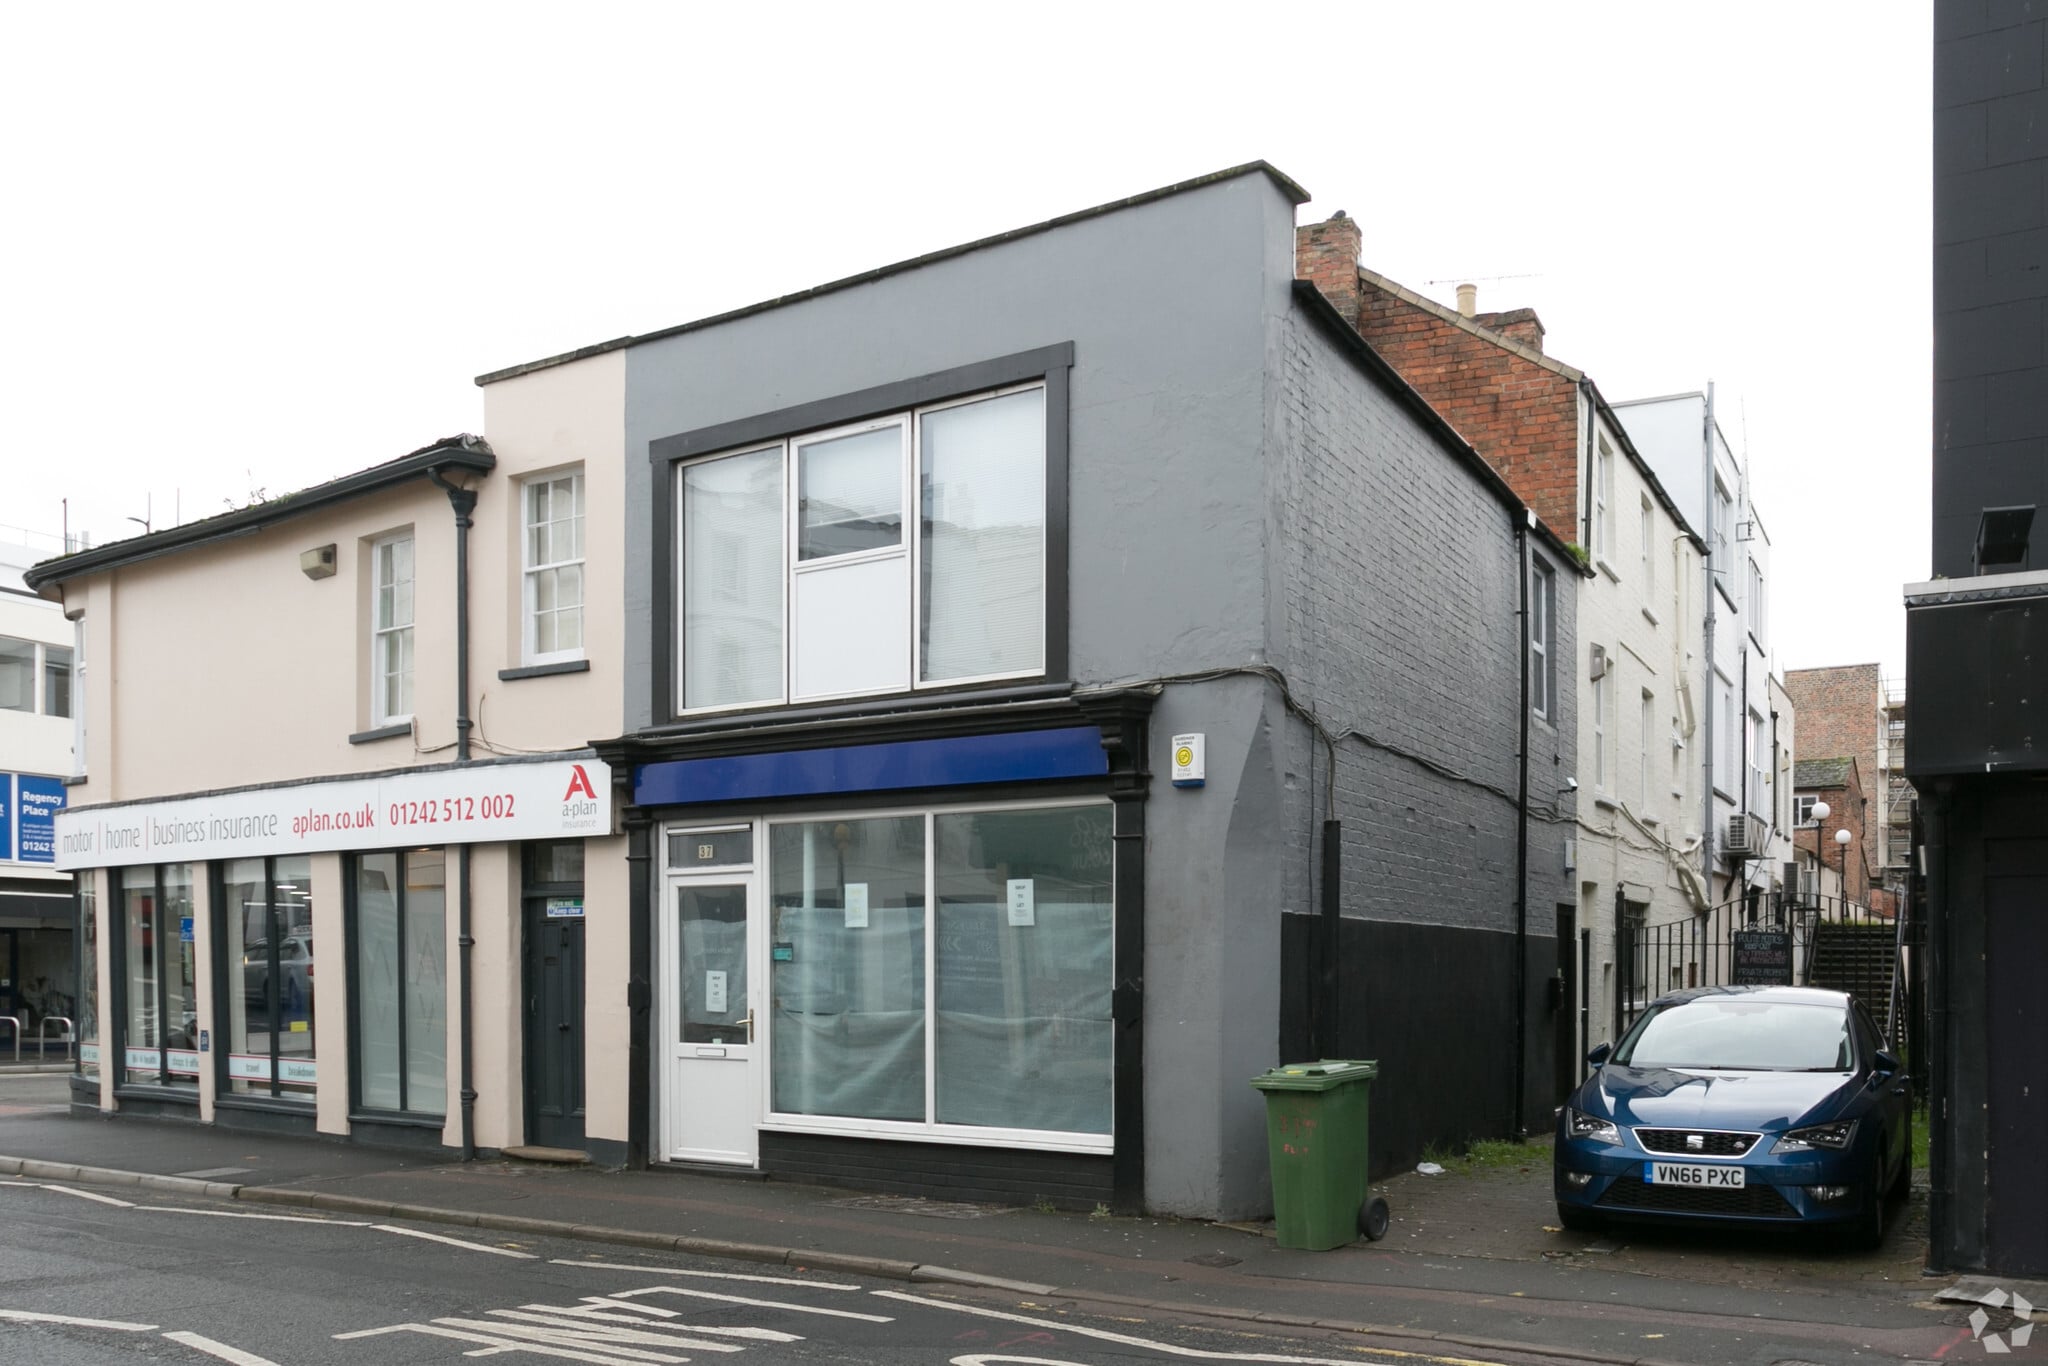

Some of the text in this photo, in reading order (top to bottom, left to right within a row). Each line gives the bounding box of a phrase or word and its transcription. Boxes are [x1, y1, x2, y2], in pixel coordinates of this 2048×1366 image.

[22, 791, 63, 806] Regency
[22, 805, 49, 816] Place
[562, 800, 598, 818] a-plan
[63, 793, 515, 854] motor home business insurance aplan.co.uk 01242 512 002
[561, 818, 597, 829] insurance
[22, 841, 50, 852] 01242
[699, 846, 713, 858] 37
[1737, 934, 1784, 944] POLITE NOTICE
[245, 1063, 260, 1073] travel
[1658, 1166, 1742, 1185] VN66 PXC
